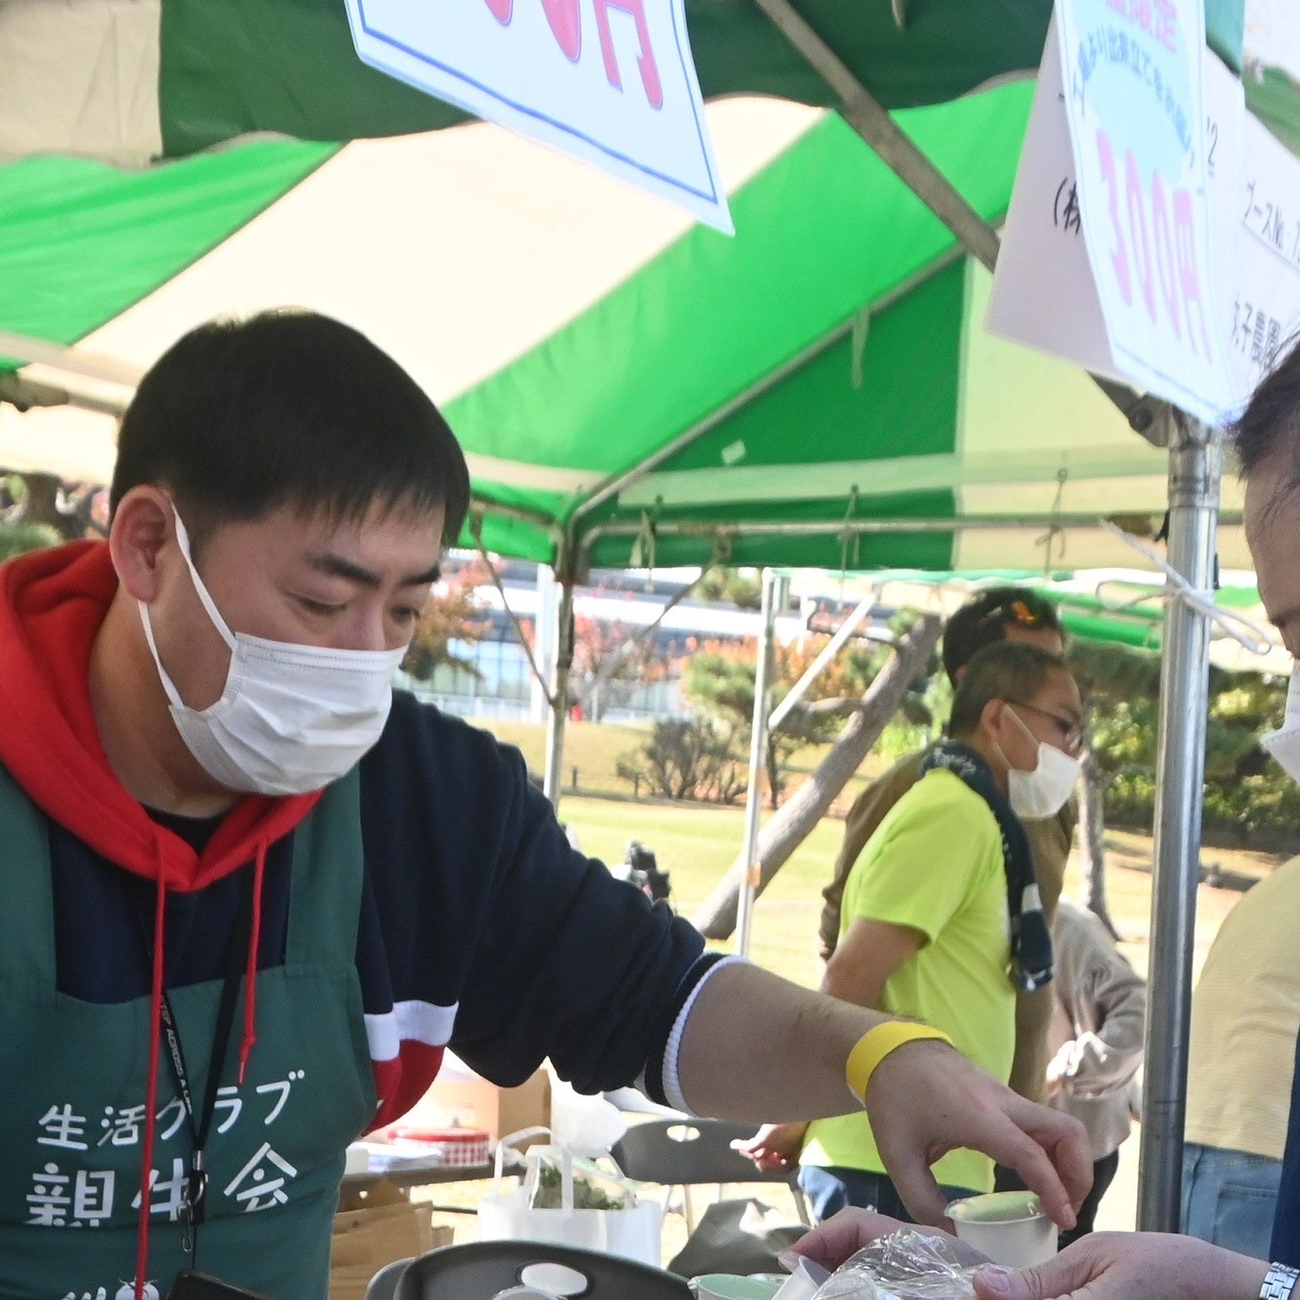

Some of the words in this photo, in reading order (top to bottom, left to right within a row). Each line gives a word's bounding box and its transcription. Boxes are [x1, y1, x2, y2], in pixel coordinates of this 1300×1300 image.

[1096, 129, 1212, 363] 300円
[165, 1028, 186, 1077] ACROSS
[37, 1069, 305, 1151] 生活クラブ
[26, 1142, 297, 1227] 親生会
